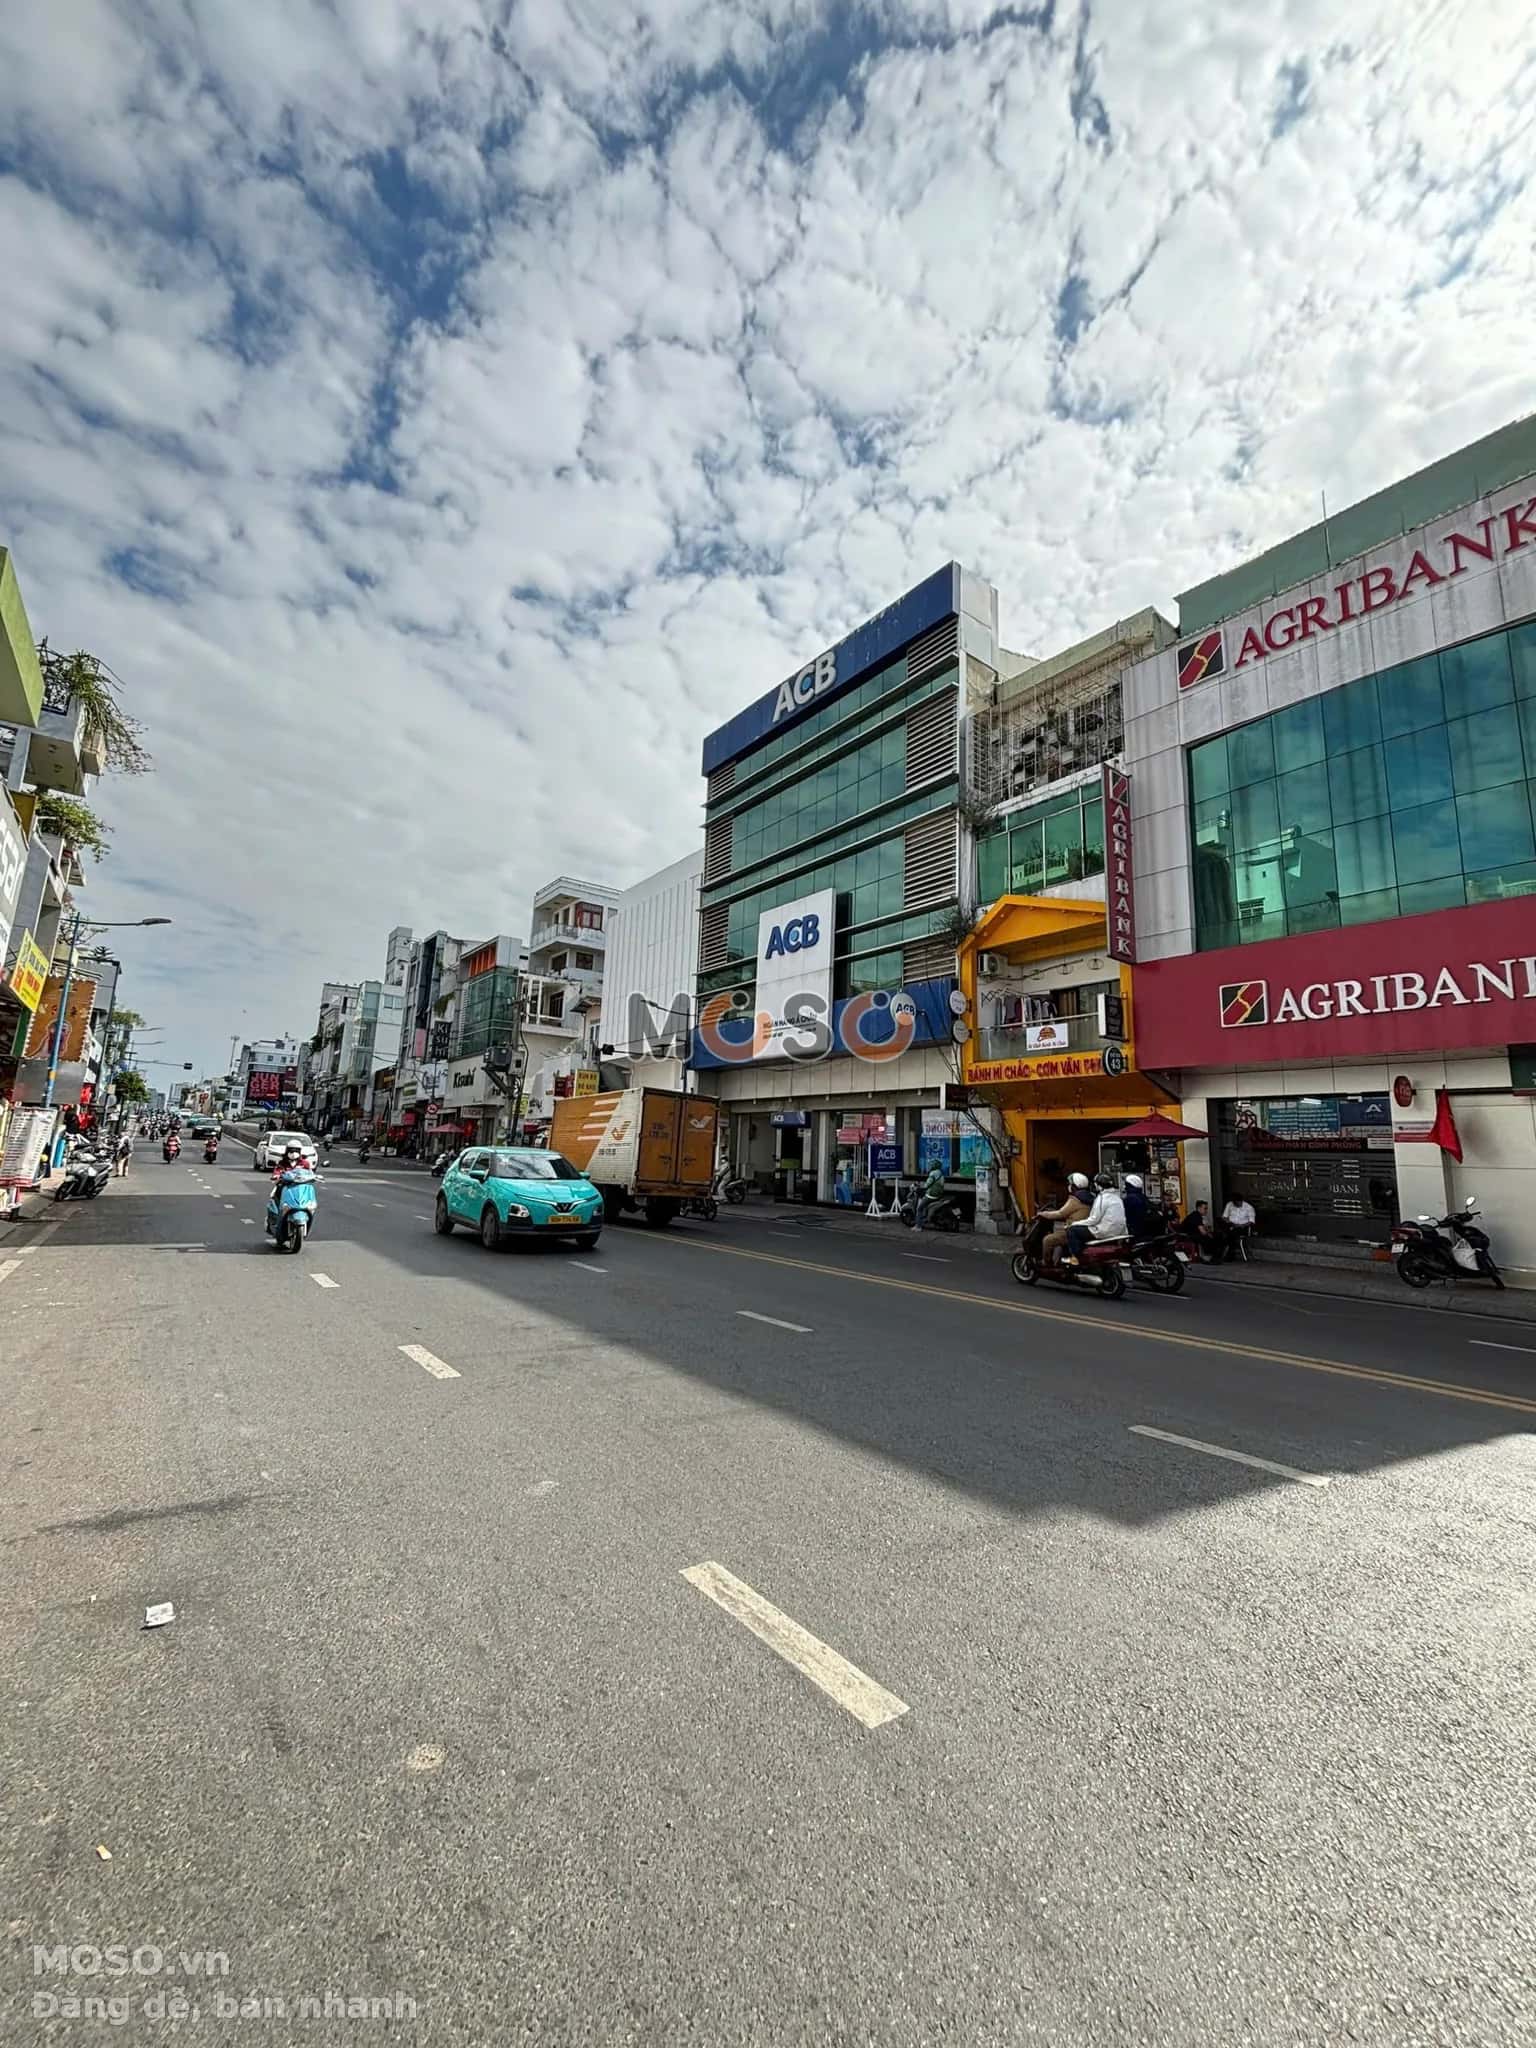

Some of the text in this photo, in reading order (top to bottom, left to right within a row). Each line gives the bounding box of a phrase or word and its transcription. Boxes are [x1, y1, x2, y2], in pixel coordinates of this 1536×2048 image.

[1234, 496, 1536, 669] AGRIBANK
[772, 651, 836, 722] ACB
[1112, 805, 1131, 955] AGRIBANK
[765, 914, 820, 960] ACB
[968, 1065, 991, 1082] BÁNH
[877, 1149, 896, 1160] ACB
